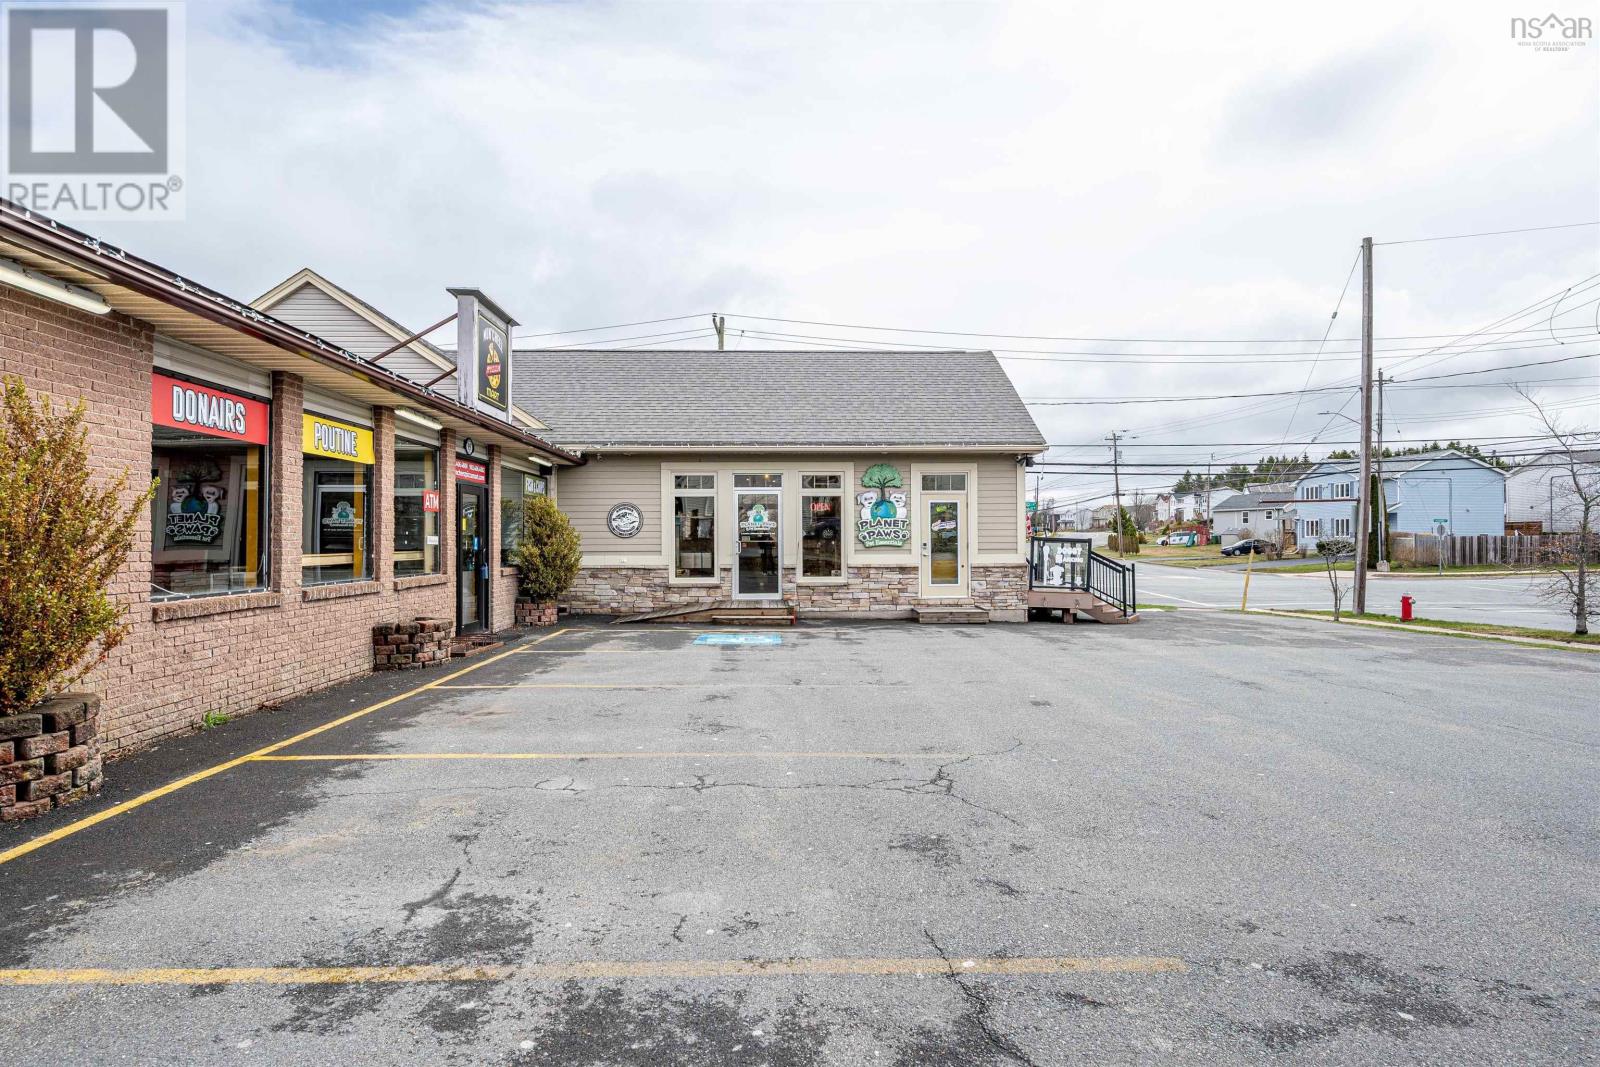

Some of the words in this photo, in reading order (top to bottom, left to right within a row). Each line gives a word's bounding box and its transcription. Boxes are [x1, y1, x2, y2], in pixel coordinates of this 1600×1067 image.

[172, 384, 246, 435] DONAIRS
[314, 421, 358, 457] POUTINE
[425, 491, 439, 509] ATM
[859, 518, 909, 530] PLANET
[866, 529, 902, 540] PAWS
